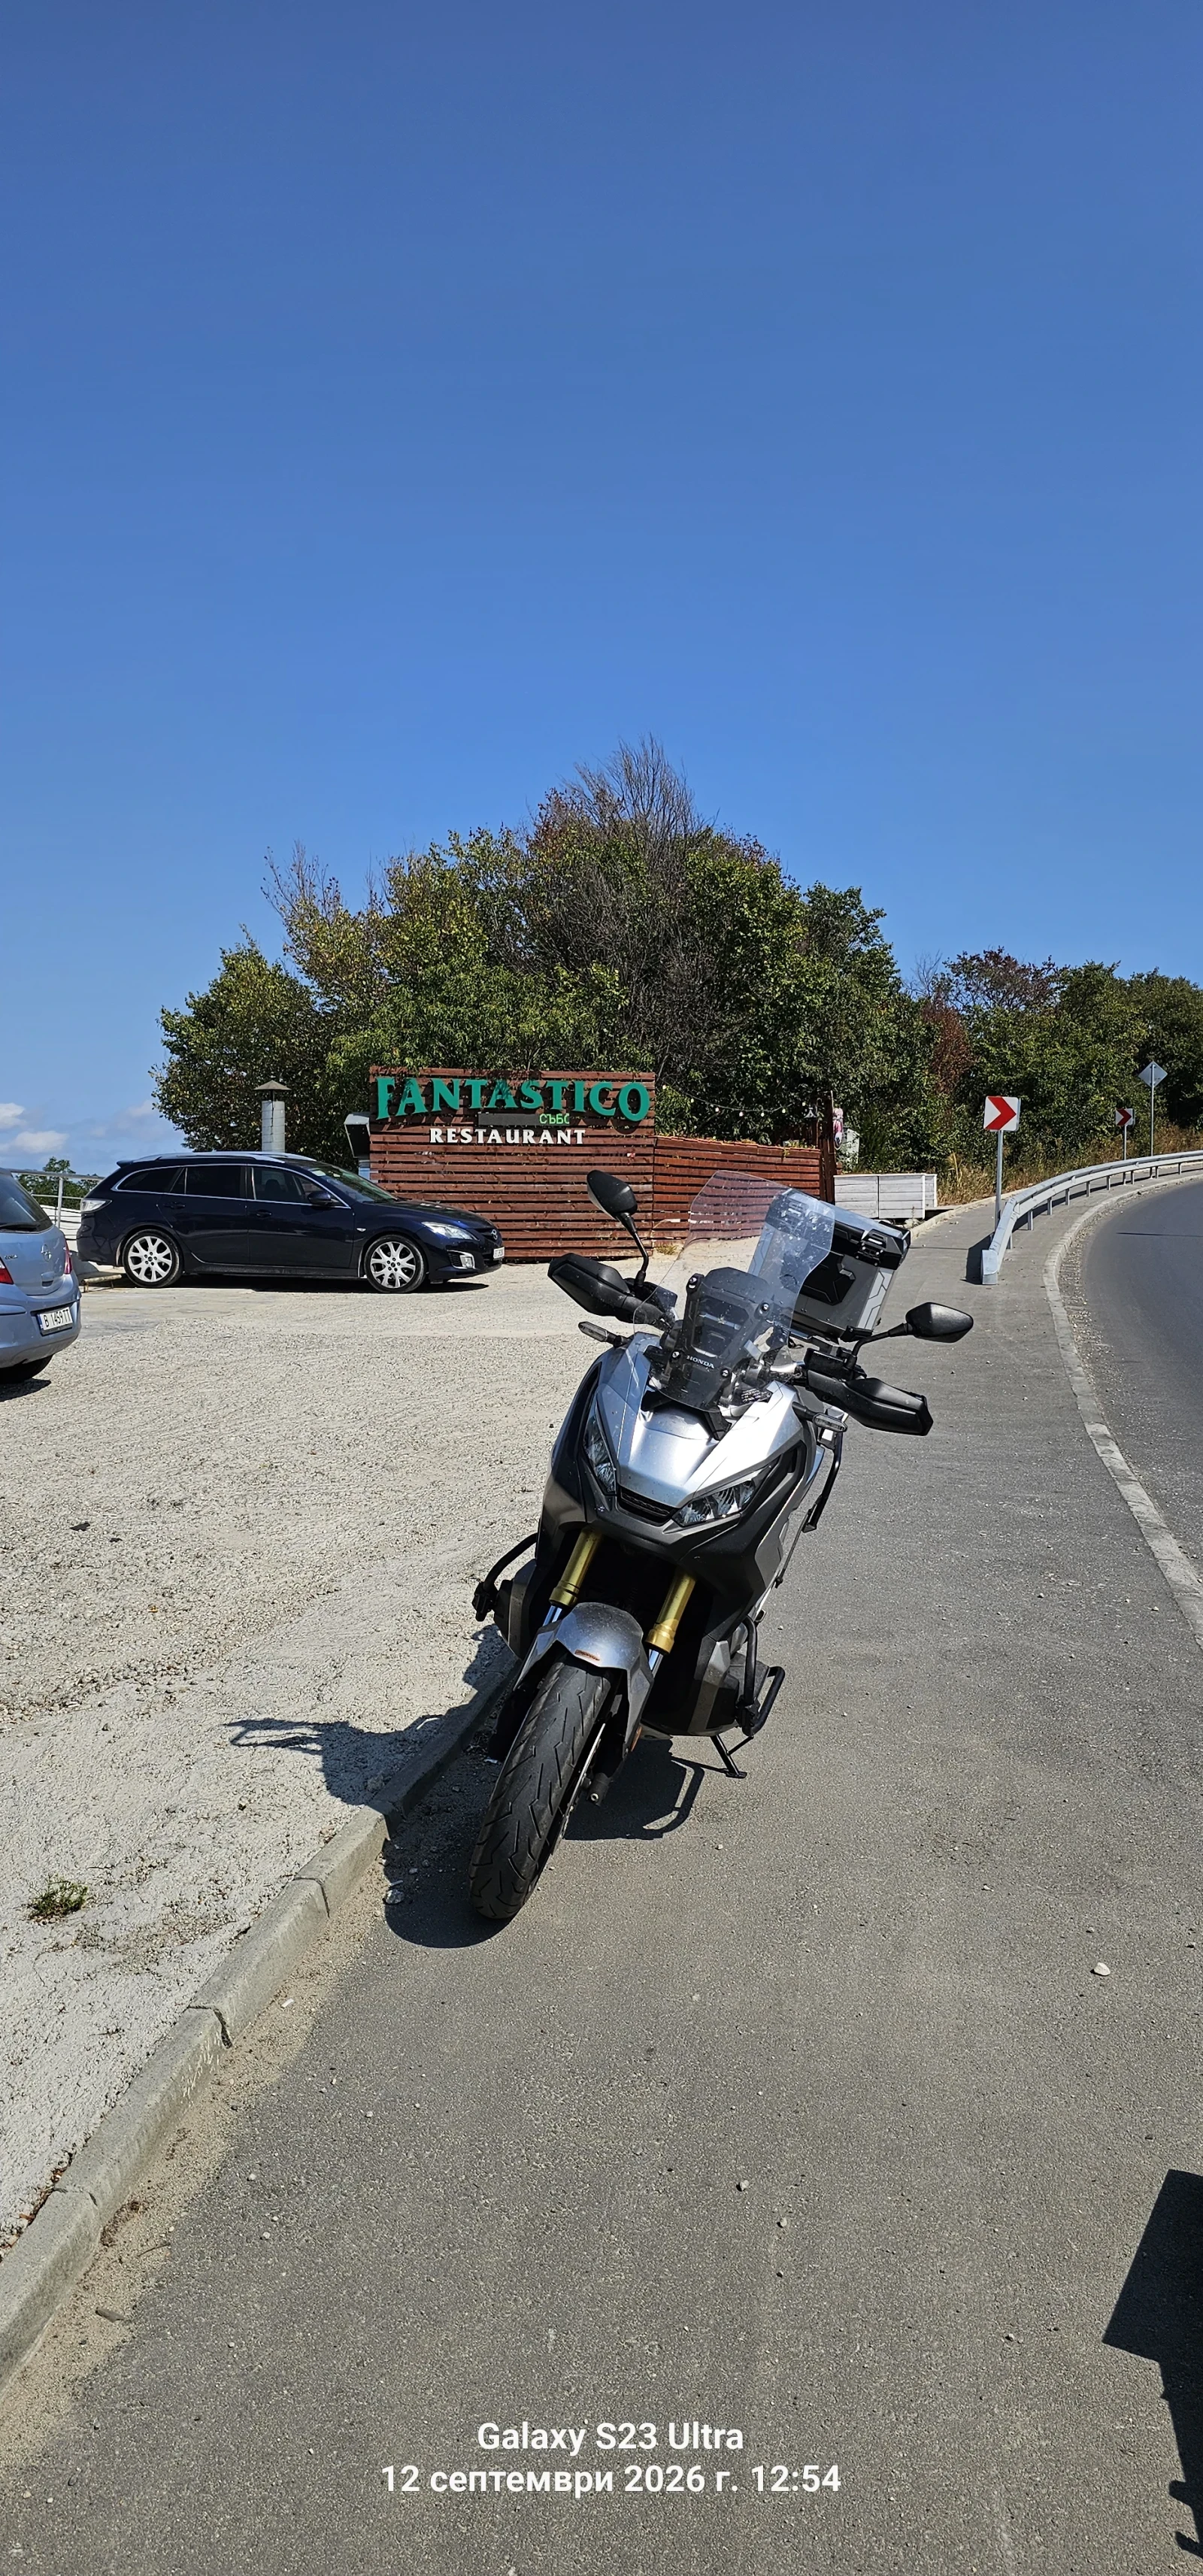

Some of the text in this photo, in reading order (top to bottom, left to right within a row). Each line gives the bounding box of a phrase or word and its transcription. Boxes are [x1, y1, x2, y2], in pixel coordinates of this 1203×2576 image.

[377, 1077, 650, 1121] FANTASTICO
[429, 1128, 586, 1144] RESTAURANT
[686, 1355, 715, 1369] HONDA
